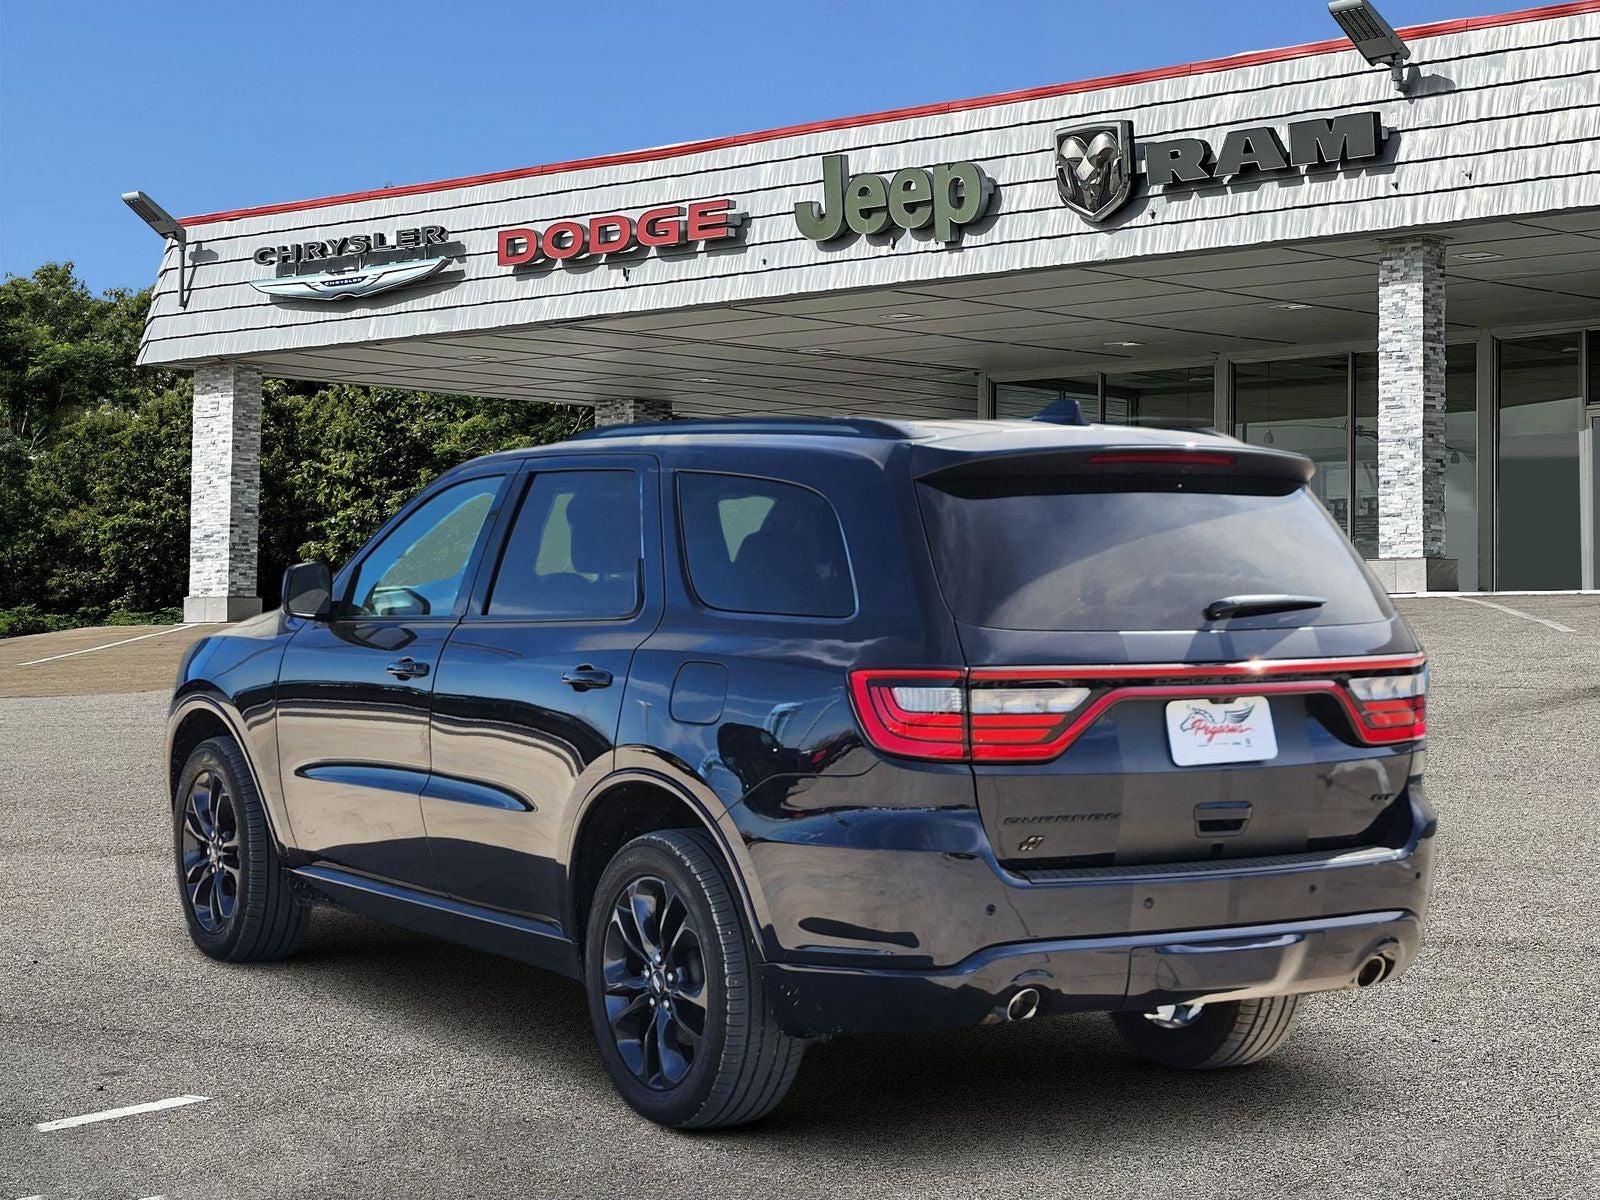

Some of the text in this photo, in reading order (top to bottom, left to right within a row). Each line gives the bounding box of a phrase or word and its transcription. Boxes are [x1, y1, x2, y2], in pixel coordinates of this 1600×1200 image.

[1146, 110, 1381, 187] RAM
[794, 154, 985, 243] Jeep
[253, 224, 448, 267] CHRYSLER
[497, 199, 735, 267] DODGE
[324, 277, 363, 287] CHRYSLER
